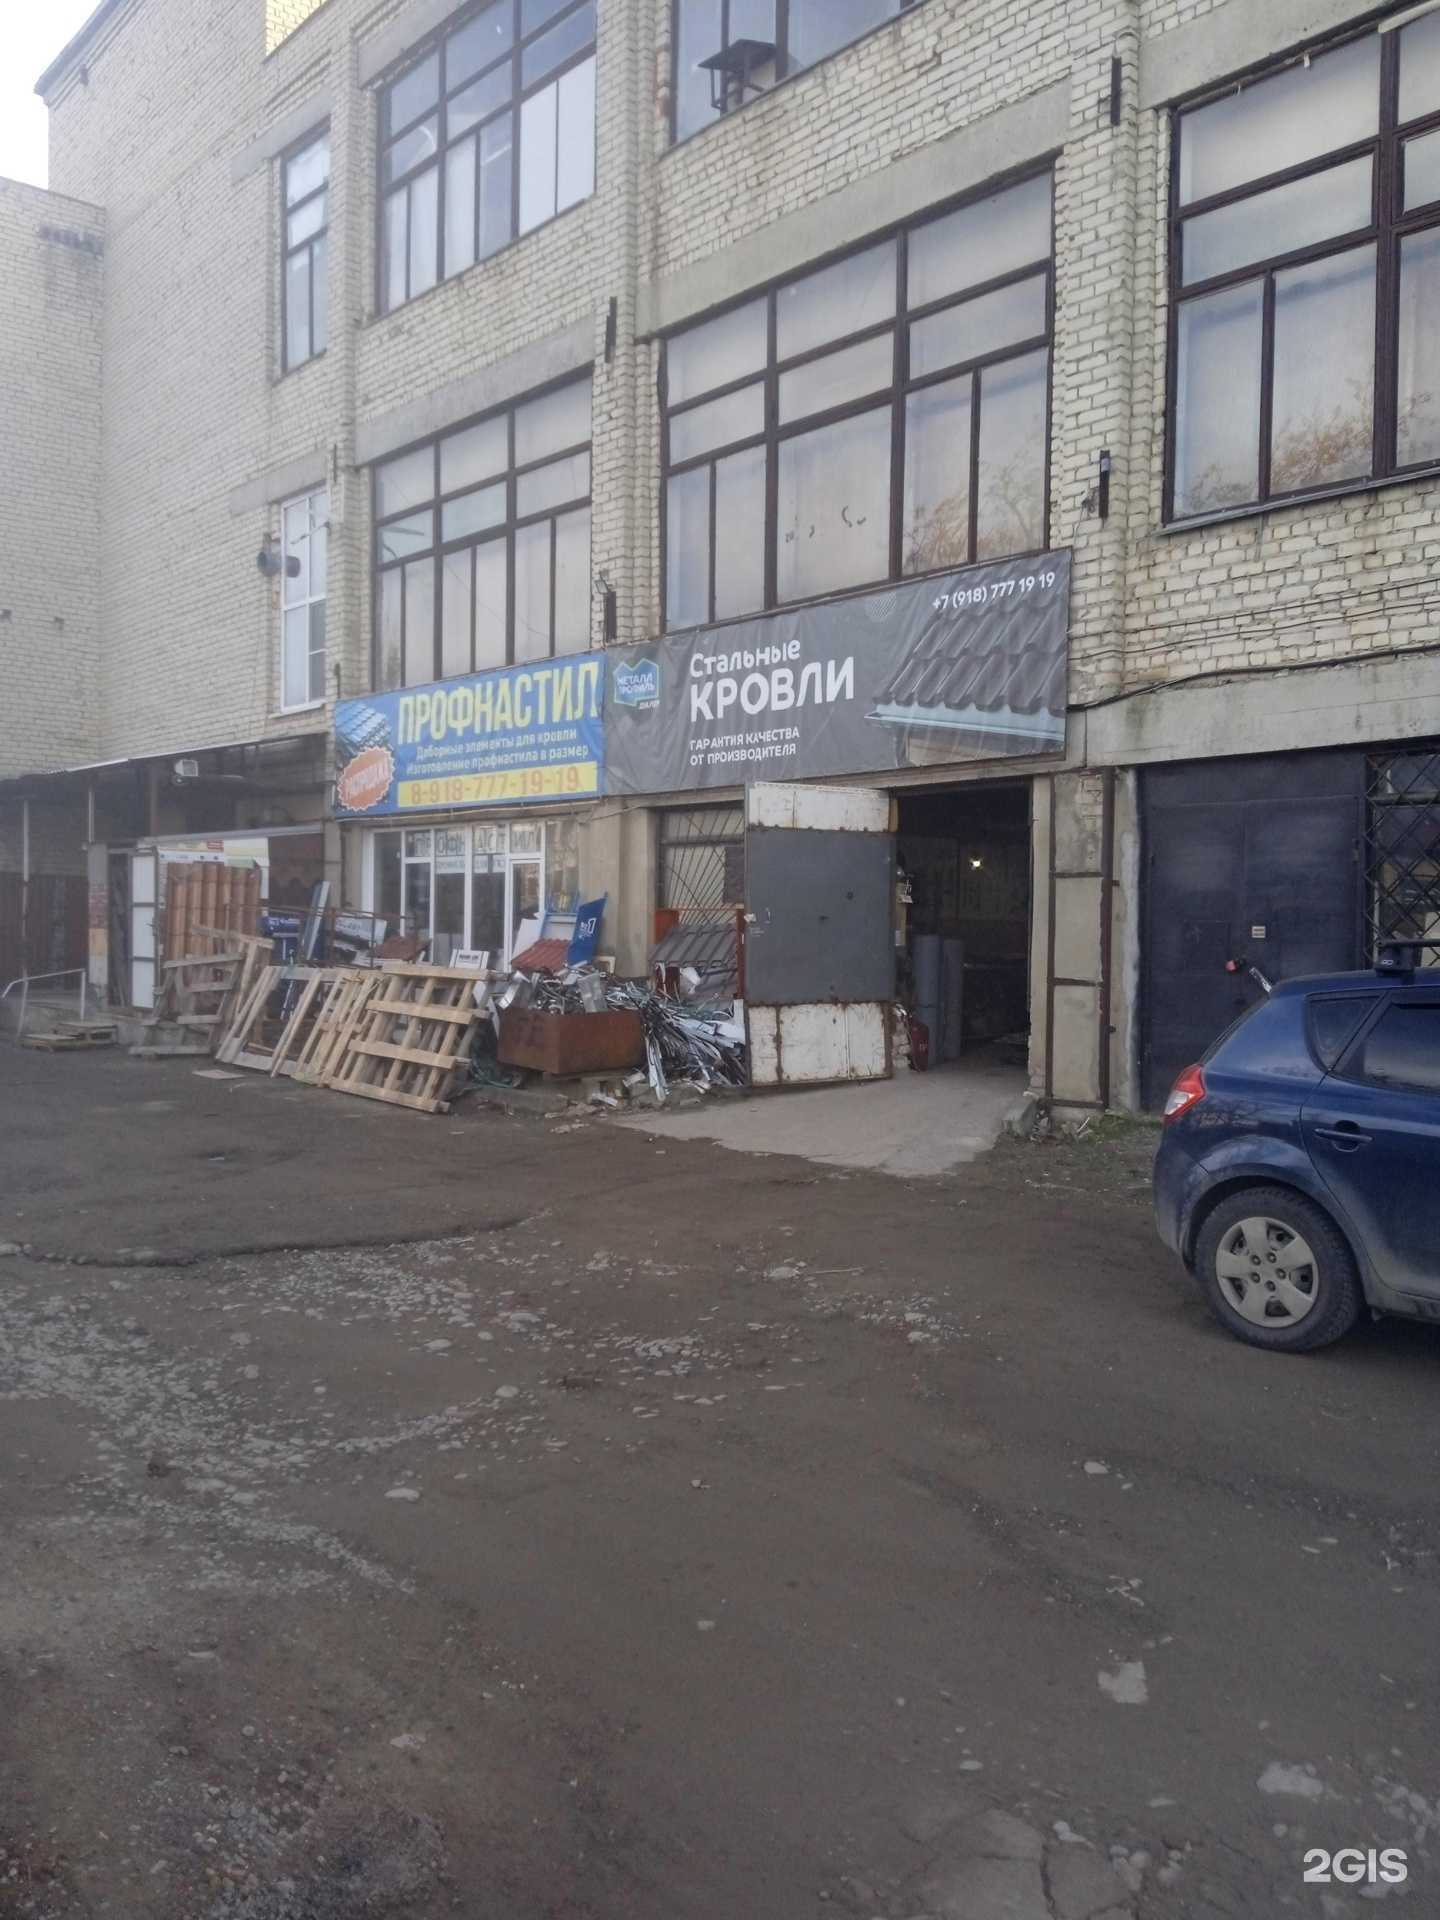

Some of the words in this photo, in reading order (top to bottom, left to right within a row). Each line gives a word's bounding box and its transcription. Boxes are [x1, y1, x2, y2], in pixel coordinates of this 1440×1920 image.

[932, 594, 949, 609] +7
[952, 586, 987, 609] (918)
[991, 580, 1015, 598] 777
[1019, 576, 1035, 592] 19
[1039, 572, 1055, 588] 19
[690, 639, 800, 678] Стальные
[397, 661, 599, 745] ПРОФНАСТИЛ
[690, 656, 854, 723] КРОВЛИ
[516, 733, 535, 747] для
[538, 728, 577, 746] кровли
[690, 733, 744, 750] ГАРАНТИЯ
[745, 727, 800, 744] КАЧЕСТВА
[690, 754, 704, 766] ОТ
[707, 743, 796, 765] ПРОИЗВОДИТЕЛЯ
[471, 750, 538, 771] профнастила
[540, 750, 546, 758] в
[549, 744, 589, 760] размер
[411, 765, 580, 805] 8-918-777-19-19
